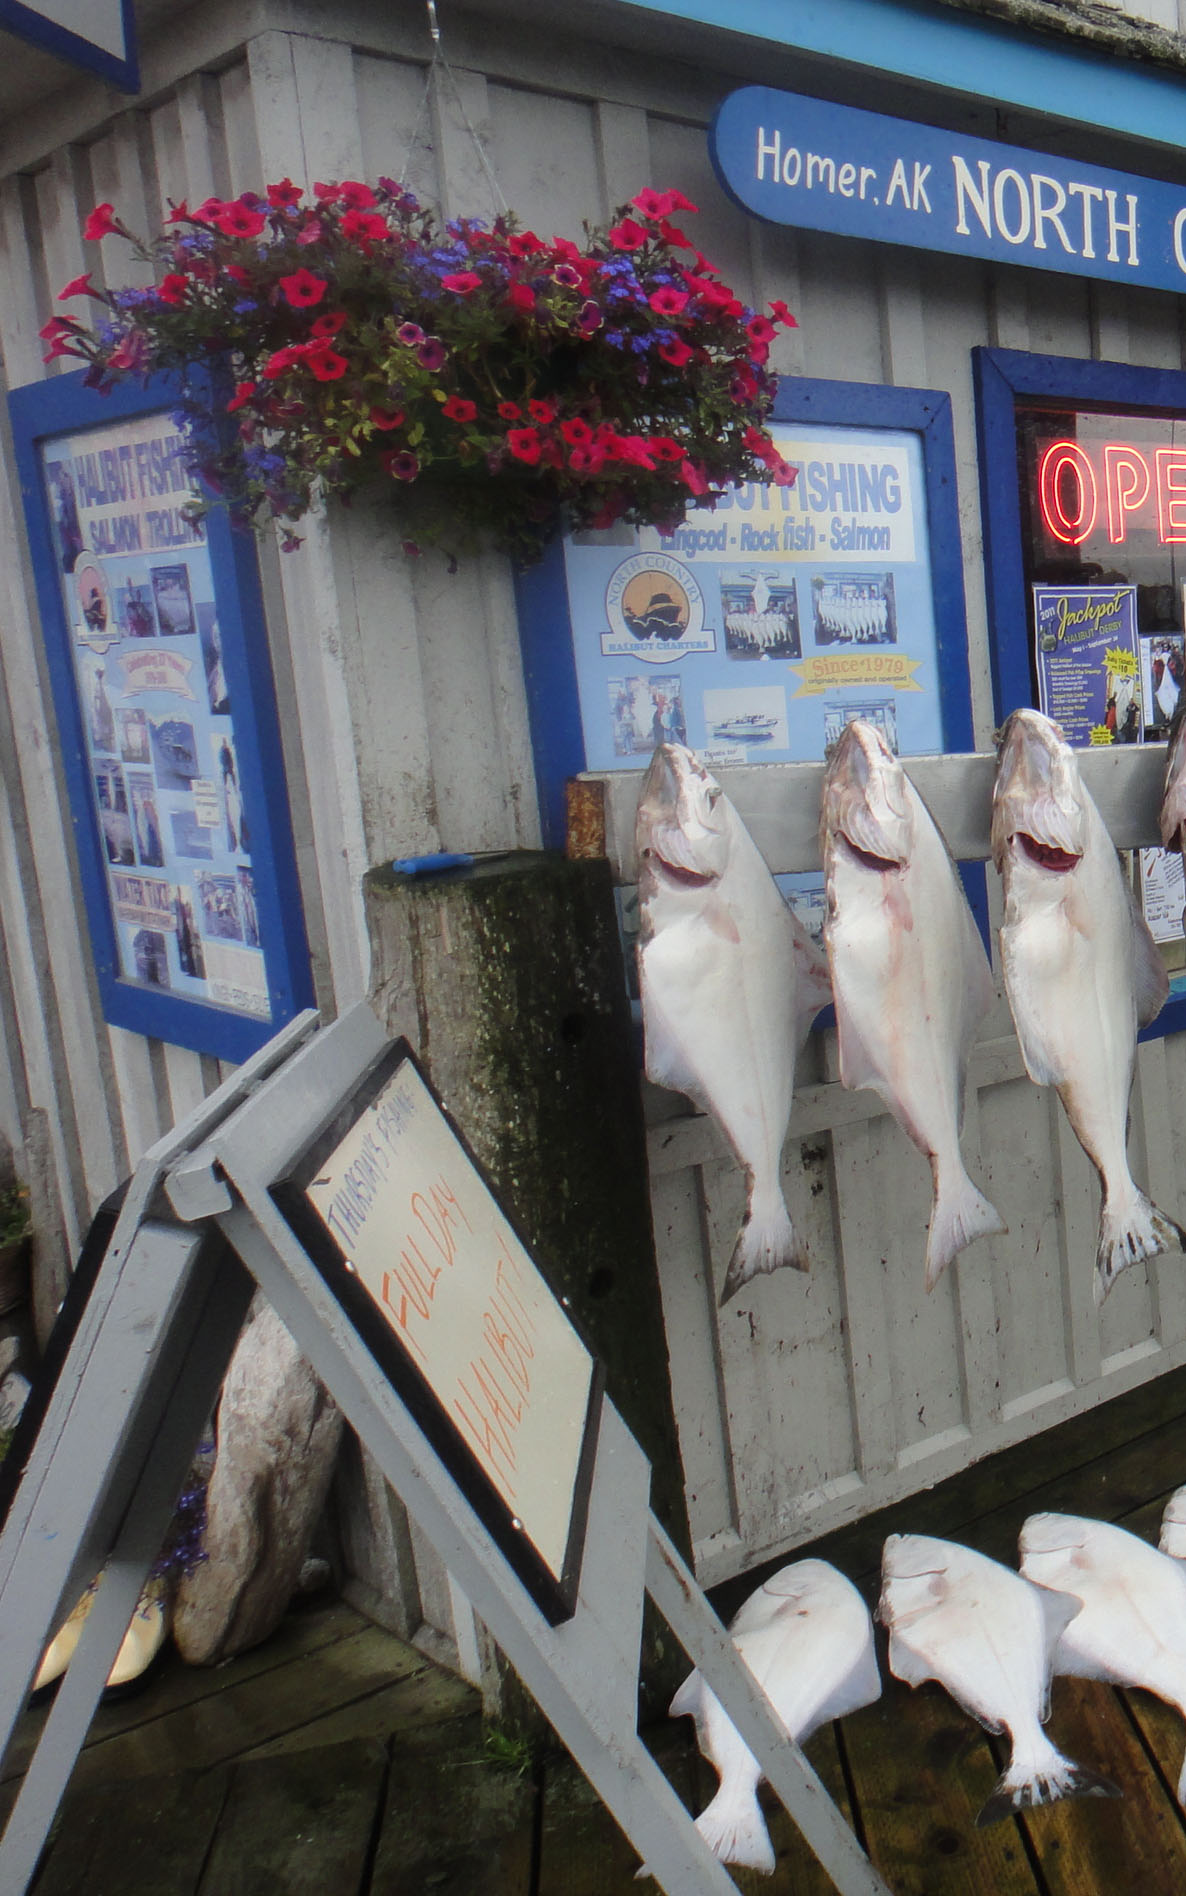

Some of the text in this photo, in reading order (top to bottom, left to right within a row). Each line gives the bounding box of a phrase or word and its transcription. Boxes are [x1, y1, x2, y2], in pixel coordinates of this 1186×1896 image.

[886, 158, 932, 214] AK
[952, 155, 1139, 266] NORTH
[740, 523, 780, 551] Rock
[783, 516, 815, 551] fish
[830, 516, 891, 551] Salmon
[608, 556, 701, 607] NORTH COUNTRY
[1057, 590, 1130, 640] Jackpot
[1063, 621, 1122, 645] HALIBUT DERBY
[608, 640, 709, 652] HALIBUT CHARTERS
[812, 657, 859, 678] Since
[382, 1173, 474, 1362] FULL DAY
